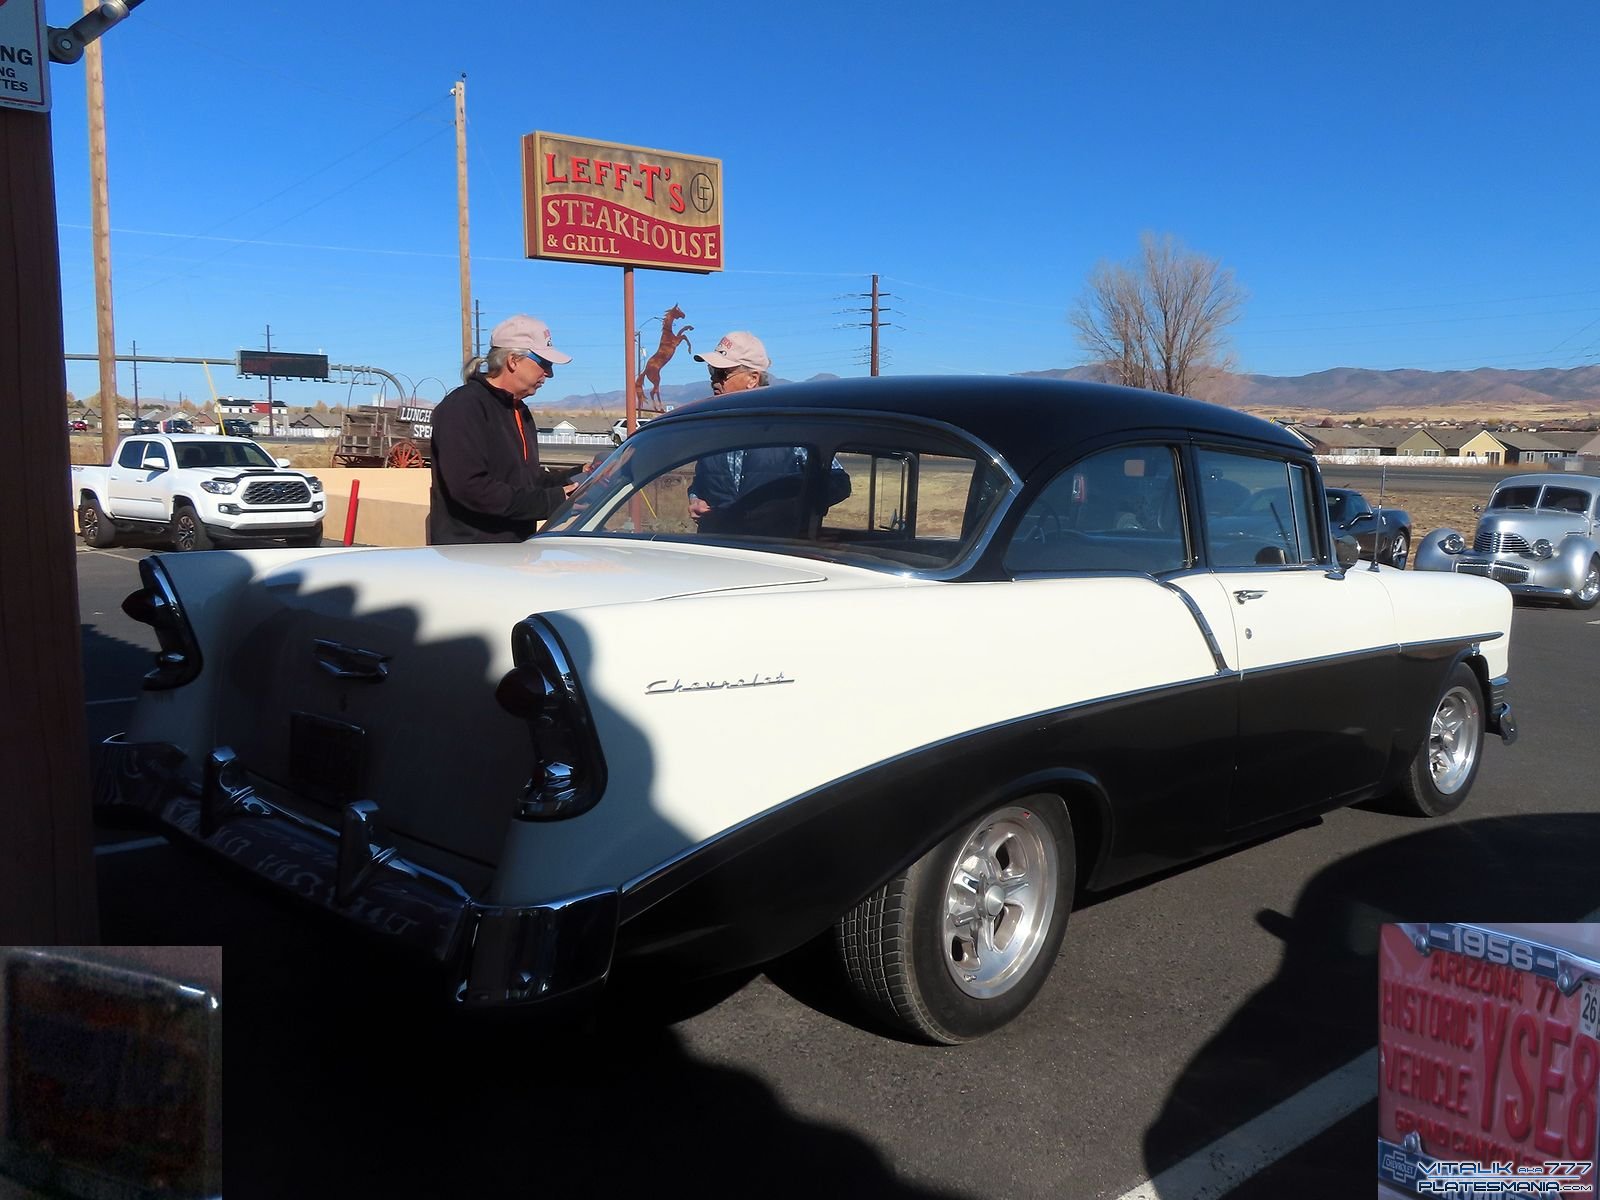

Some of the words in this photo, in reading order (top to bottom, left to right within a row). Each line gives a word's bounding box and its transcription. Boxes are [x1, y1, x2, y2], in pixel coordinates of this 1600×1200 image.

[544, 153, 686, 214] LEFF-T'S
[546, 199, 718, 260] STEAKHOUSE
[546, 234, 559, 248] &
[562, 234, 620, 254] GRILL
[400, 407, 433, 423] LUNCH
[1430, 950, 1524, 1004] ARIZONA
[1383, 978, 1476, 1049] HISTORIC
[1582, 993, 1597, 1024] 26
[1383, 1041, 1473, 1115] VEHICLE
